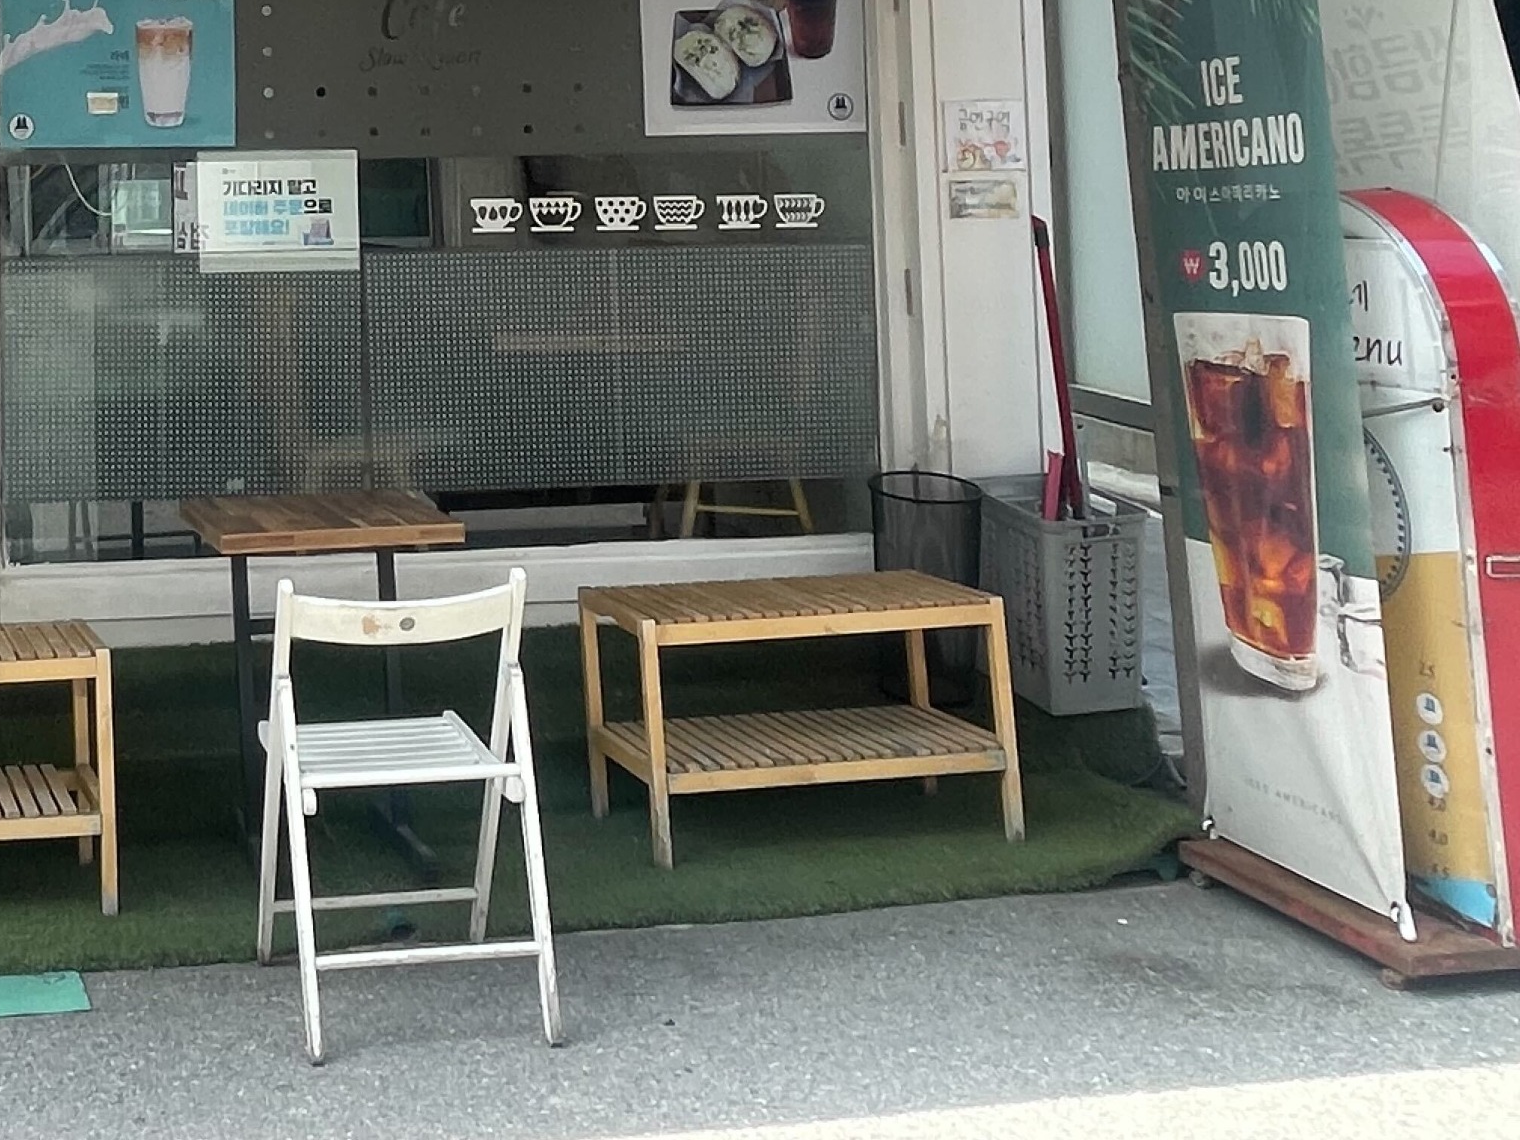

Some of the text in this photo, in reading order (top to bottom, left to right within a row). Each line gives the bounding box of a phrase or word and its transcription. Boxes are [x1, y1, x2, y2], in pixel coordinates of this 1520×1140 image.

[1201, 56, 1243, 107] ICE
[1153, 112, 1305, 172] AMERICANO
[223, 179, 316, 196] 기다리지 말고
[1209, 241, 1288, 297] 3,000
[1353, 336, 1403, 367] enu
